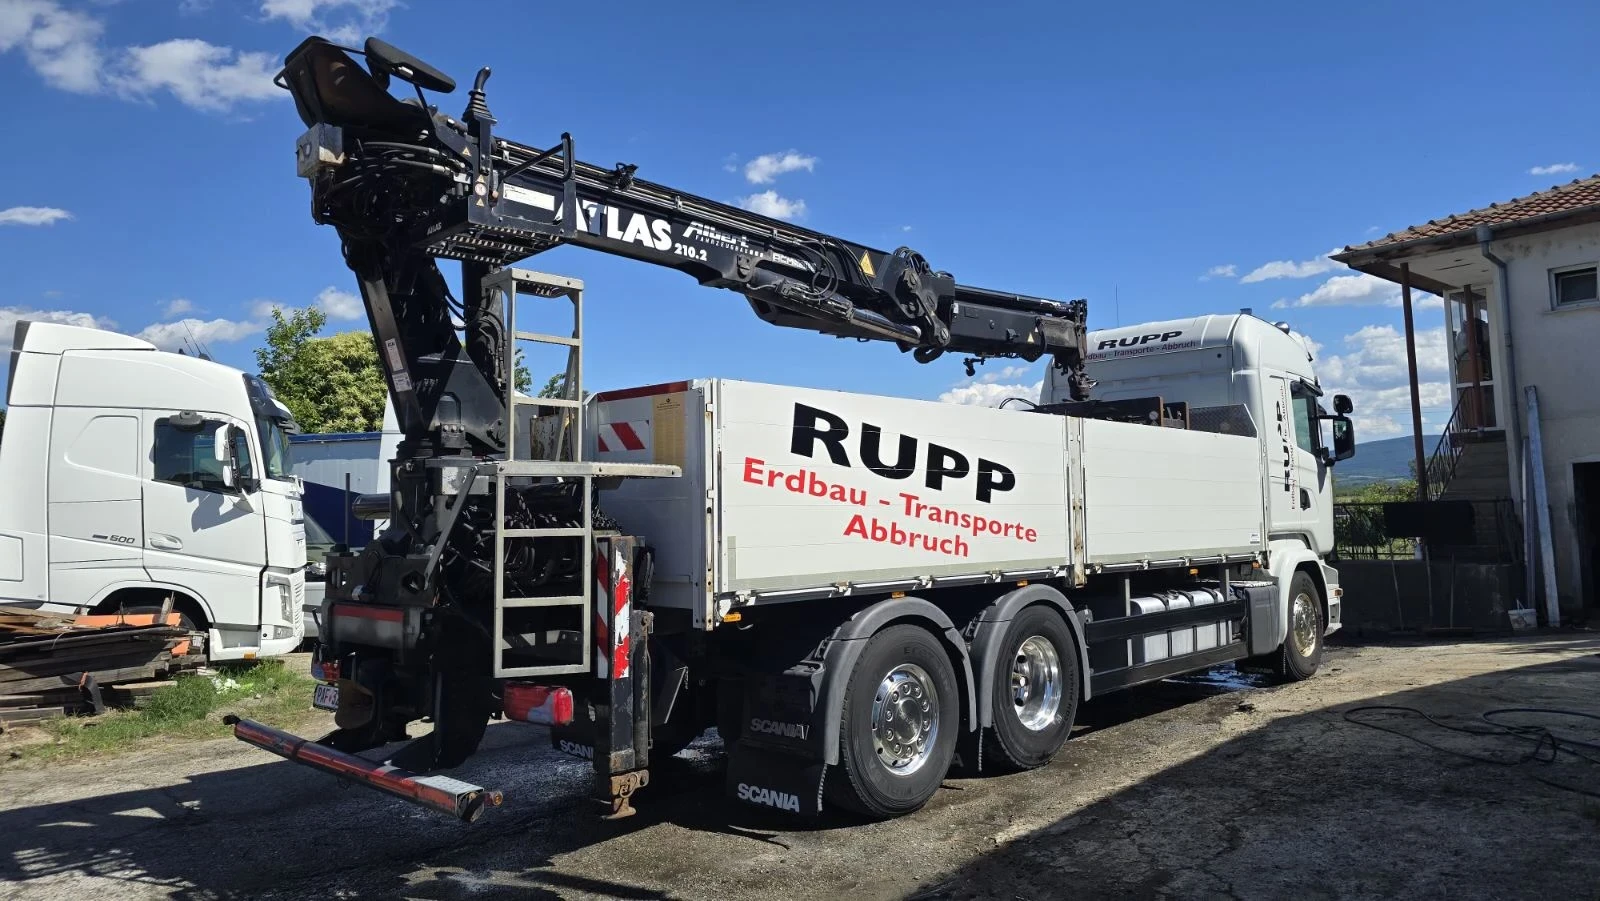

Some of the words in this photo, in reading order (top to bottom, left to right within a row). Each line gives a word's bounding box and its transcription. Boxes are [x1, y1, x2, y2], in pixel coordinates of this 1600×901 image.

[553, 197, 673, 251] ATLAS
[674, 243, 708, 262] 210.2
[1085, 352, 1107, 361] rdbau
[1114, 346, 1154, 357] Transporte
[1161, 340, 1196, 352] Abbruch
[1098, 330, 1183, 351] RUPP
[790, 402, 1016, 504] RUPP
[743, 456, 867, 506] Erdbau
[899, 492, 1038, 543] Transporte
[110, 534, 135, 544] 500
[843, 514, 969, 558] Abbruch
[750, 718, 805, 740] SCANIA
[560, 739, 595, 760] SCANI
[737, 783, 800, 813] SCANIA
